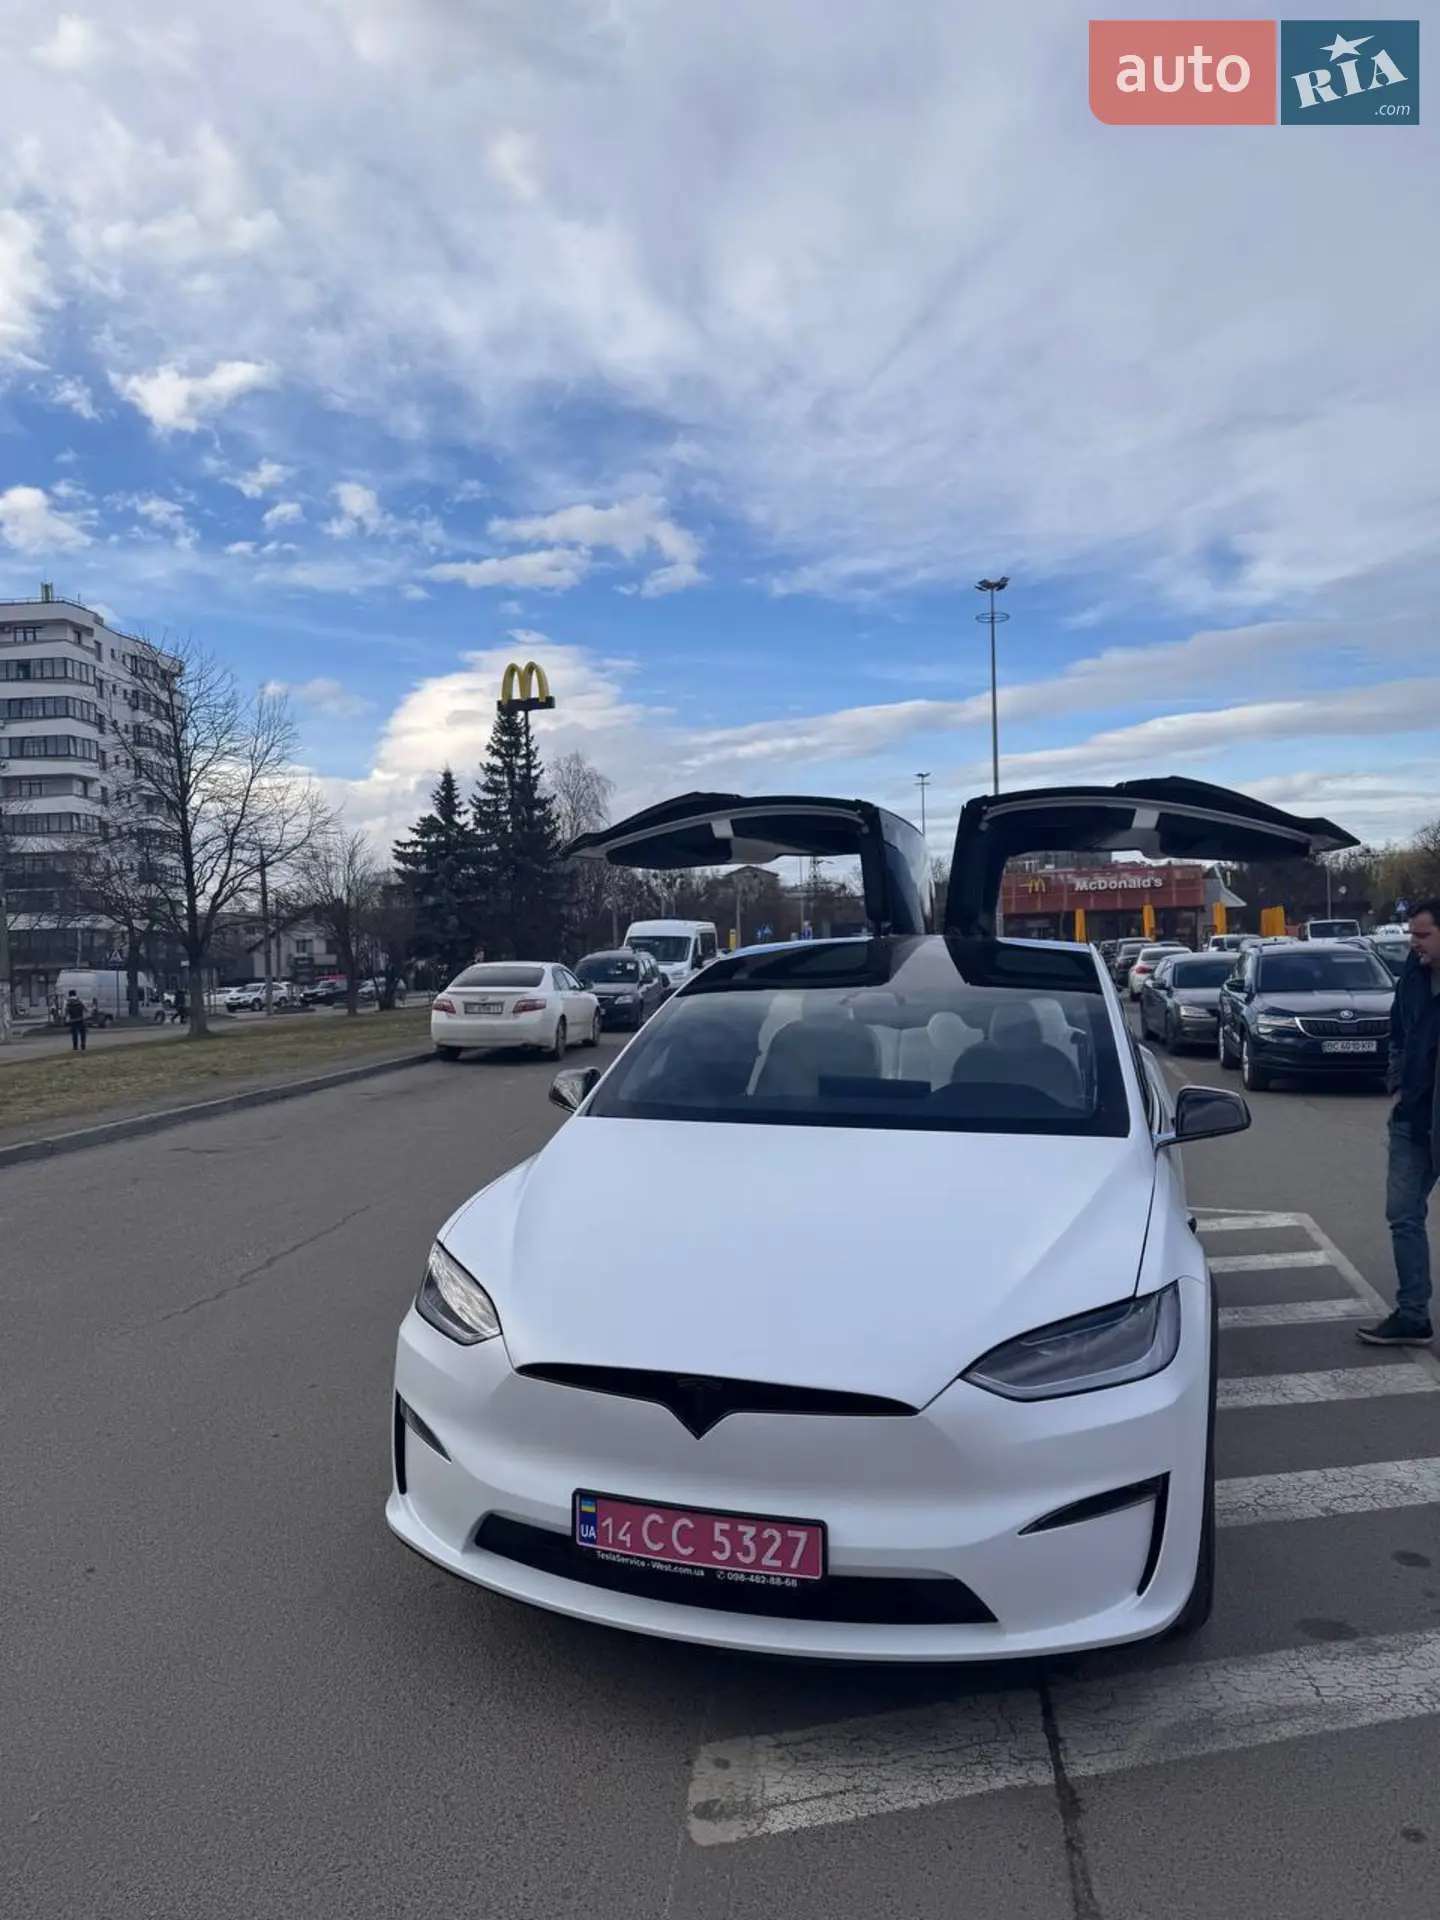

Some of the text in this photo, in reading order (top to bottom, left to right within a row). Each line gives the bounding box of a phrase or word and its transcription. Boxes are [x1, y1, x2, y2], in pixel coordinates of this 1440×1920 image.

[1074, 876, 1164, 892] McDonald's
[580, 1524, 597, 1539] UA
[601, 1513, 809, 1569] 14 CC 5327
